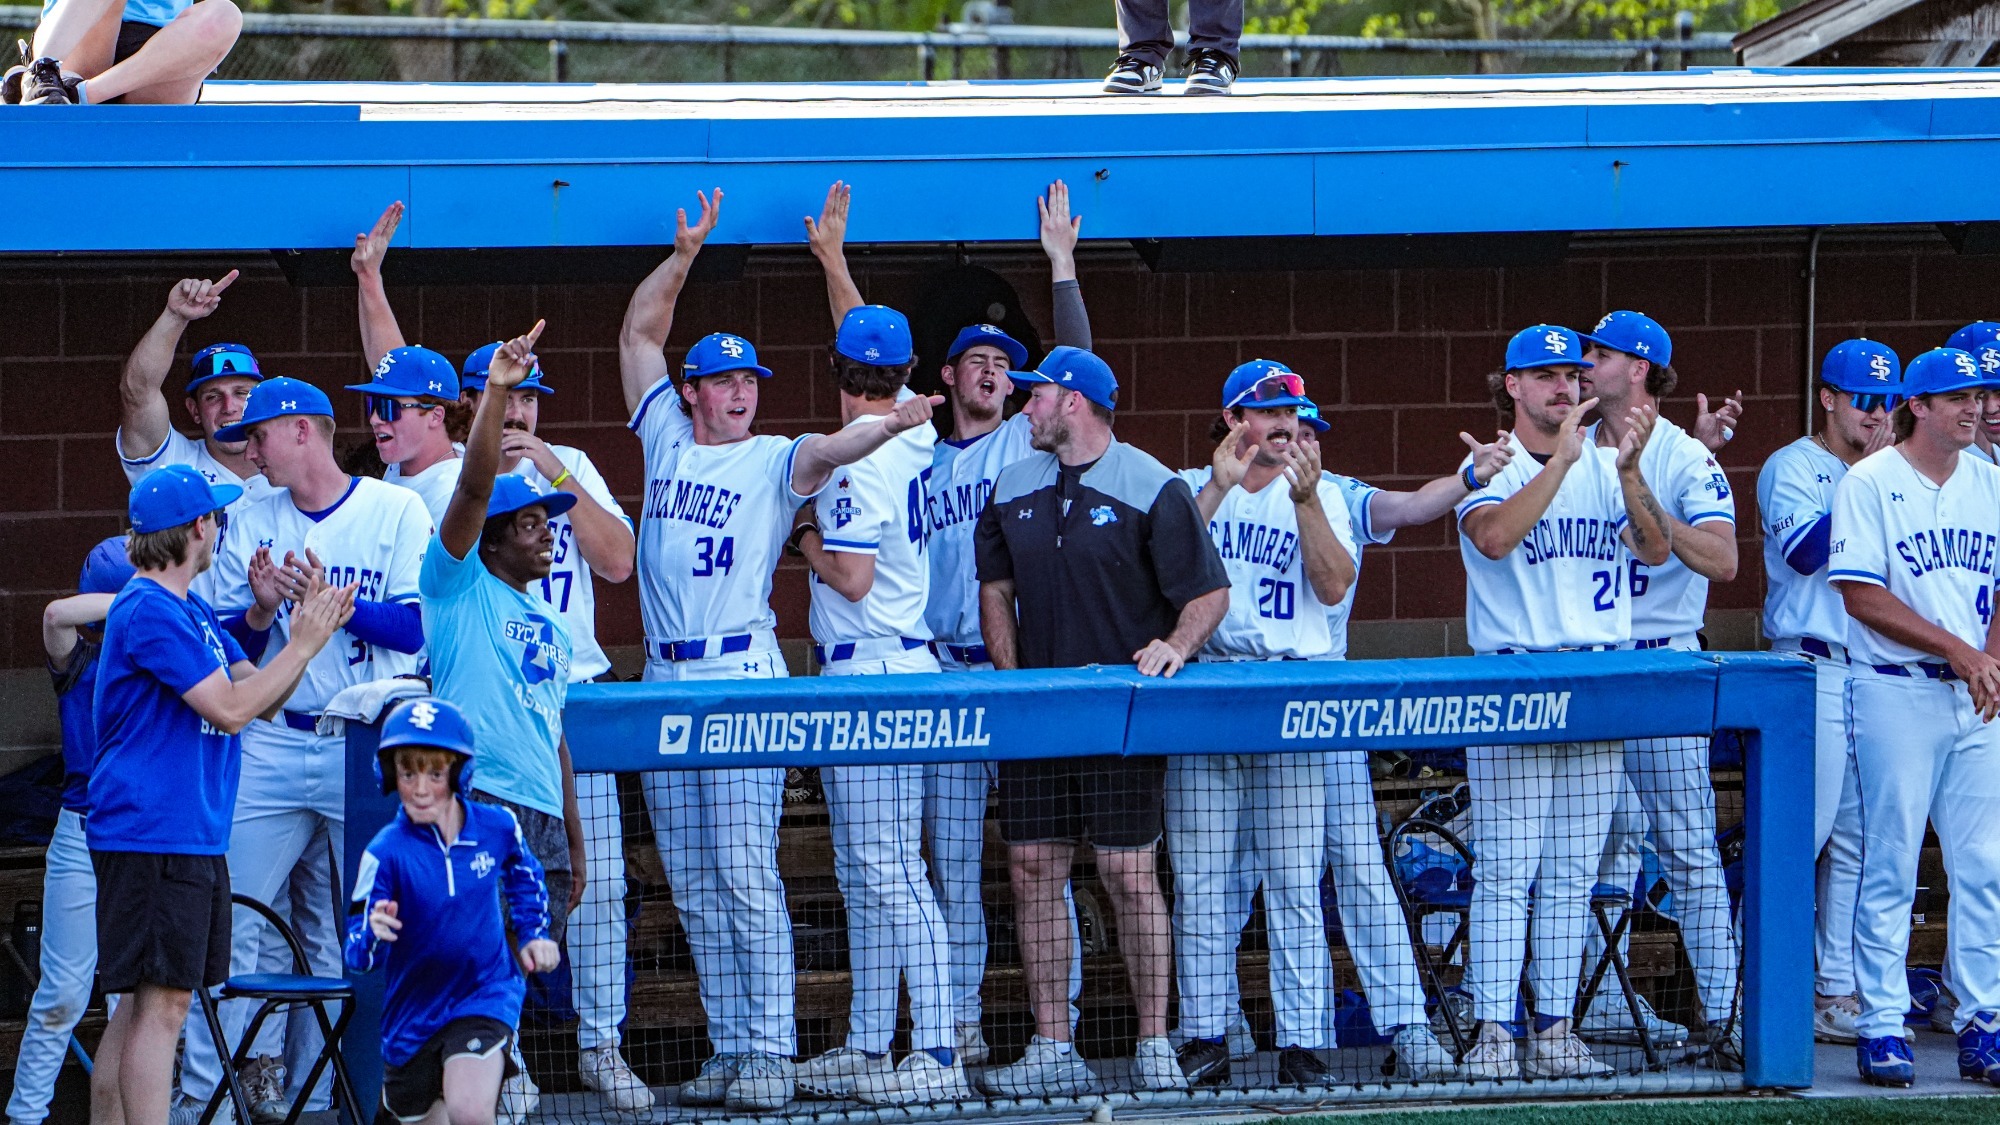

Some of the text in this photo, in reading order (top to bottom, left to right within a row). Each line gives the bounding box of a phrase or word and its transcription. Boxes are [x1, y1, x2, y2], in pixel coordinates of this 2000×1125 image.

[647, 479, 741, 529] YCMORES
[927, 479, 992, 531] CAMOR
[692, 536, 734, 577] 34
[1209, 520, 1299, 575] CAMORES
[1523, 518, 1617, 565] SCMORES
[1896, 528, 1996, 577] SCAMORE
[1258, 577, 1295, 620] 20
[506, 621, 568, 672] SYCAORES
[700, 707, 991, 754] @INDSTBASEBALL
[1281, 691, 1572, 739] GOSYCAMORES.COM
